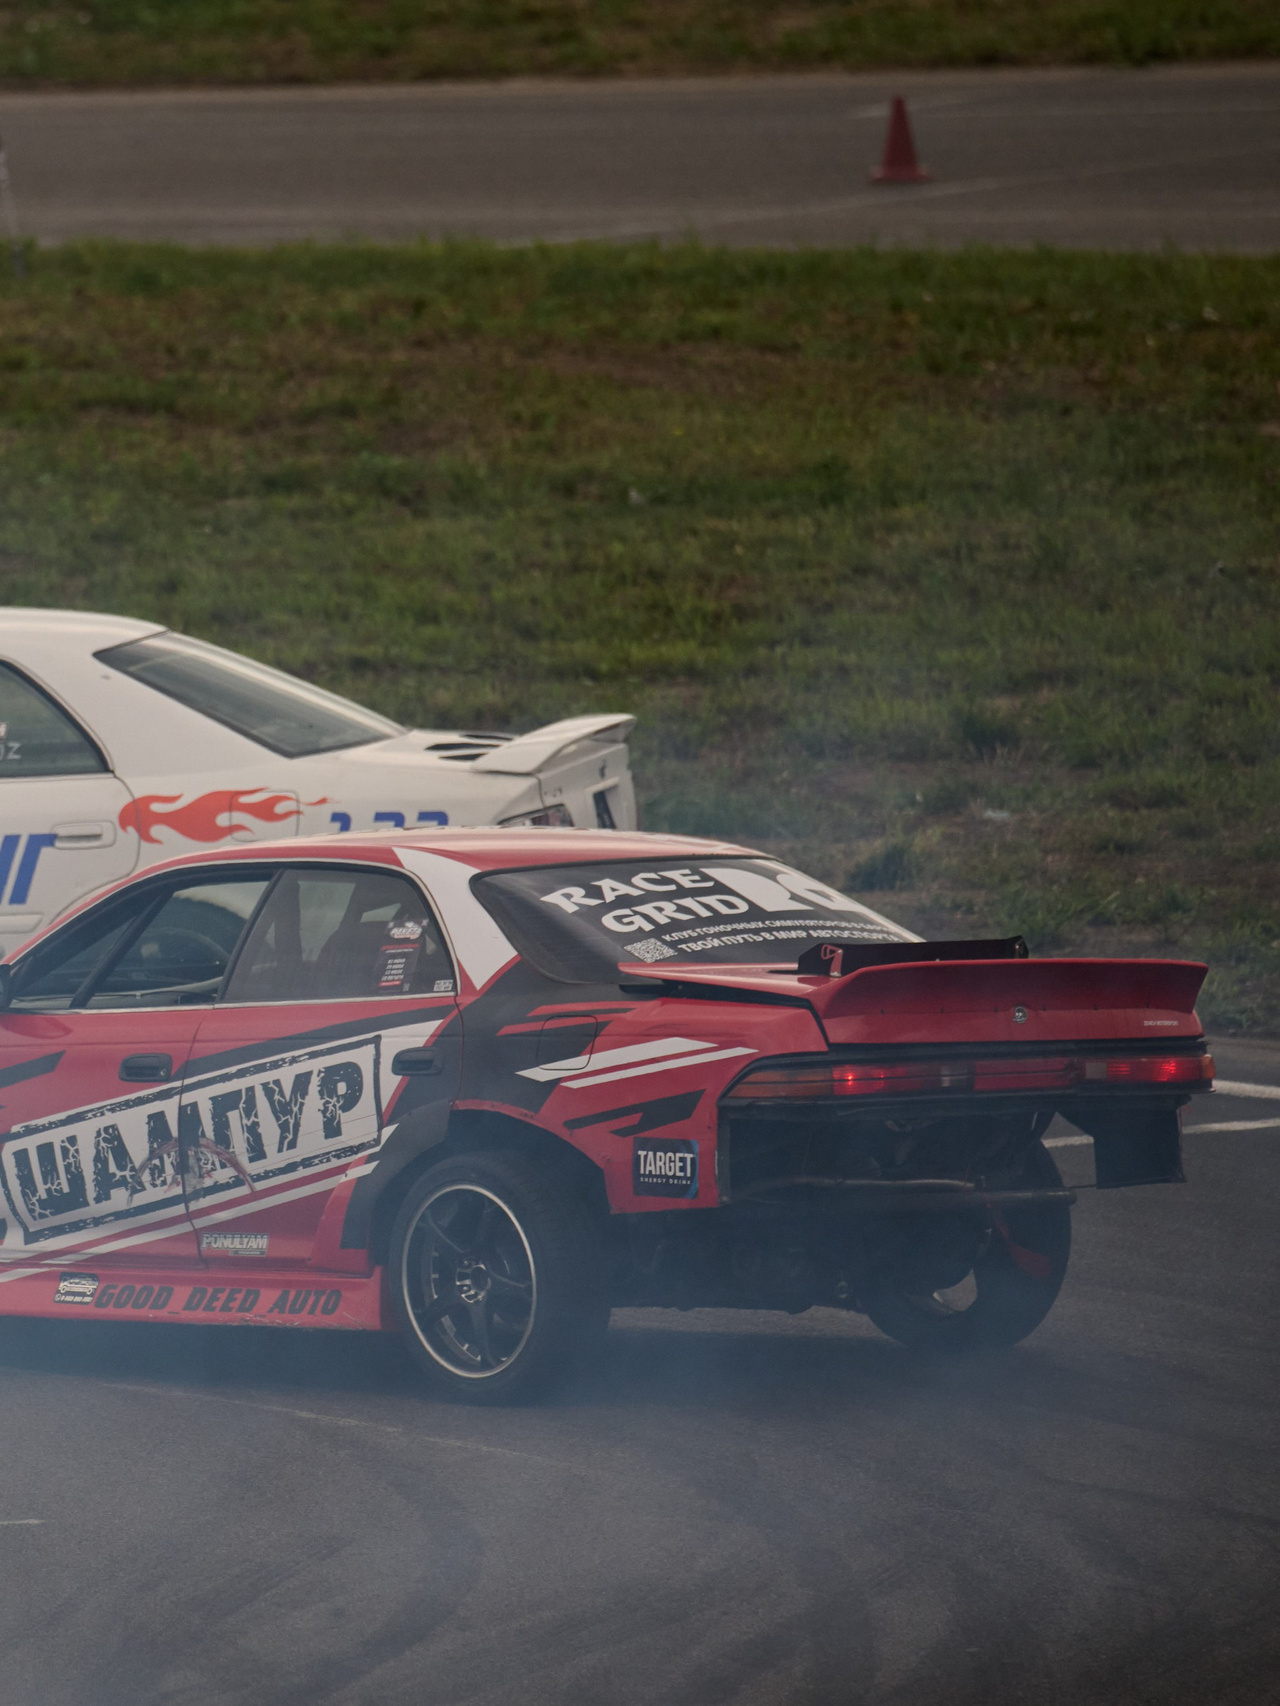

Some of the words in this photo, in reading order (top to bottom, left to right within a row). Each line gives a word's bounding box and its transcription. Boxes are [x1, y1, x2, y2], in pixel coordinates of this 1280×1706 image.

[540, 868, 715, 914] RACE
[601, 894, 749, 934] GRID
[661, 929, 697, 942] КЛУБ
[696, 920, 767, 936] ГОНОЧНЫХ
[677, 937, 724, 953] ТВОЙ
[721, 933, 765, 945] ПУТЬ
[759, 931, 775, 940] В
[775, 929, 807, 940] МИР
[13, 1061, 364, 1222] ШАМПУР
[638, 1150, 694, 1177] TARGET
[201, 1232, 269, 1250] PONULYAM
